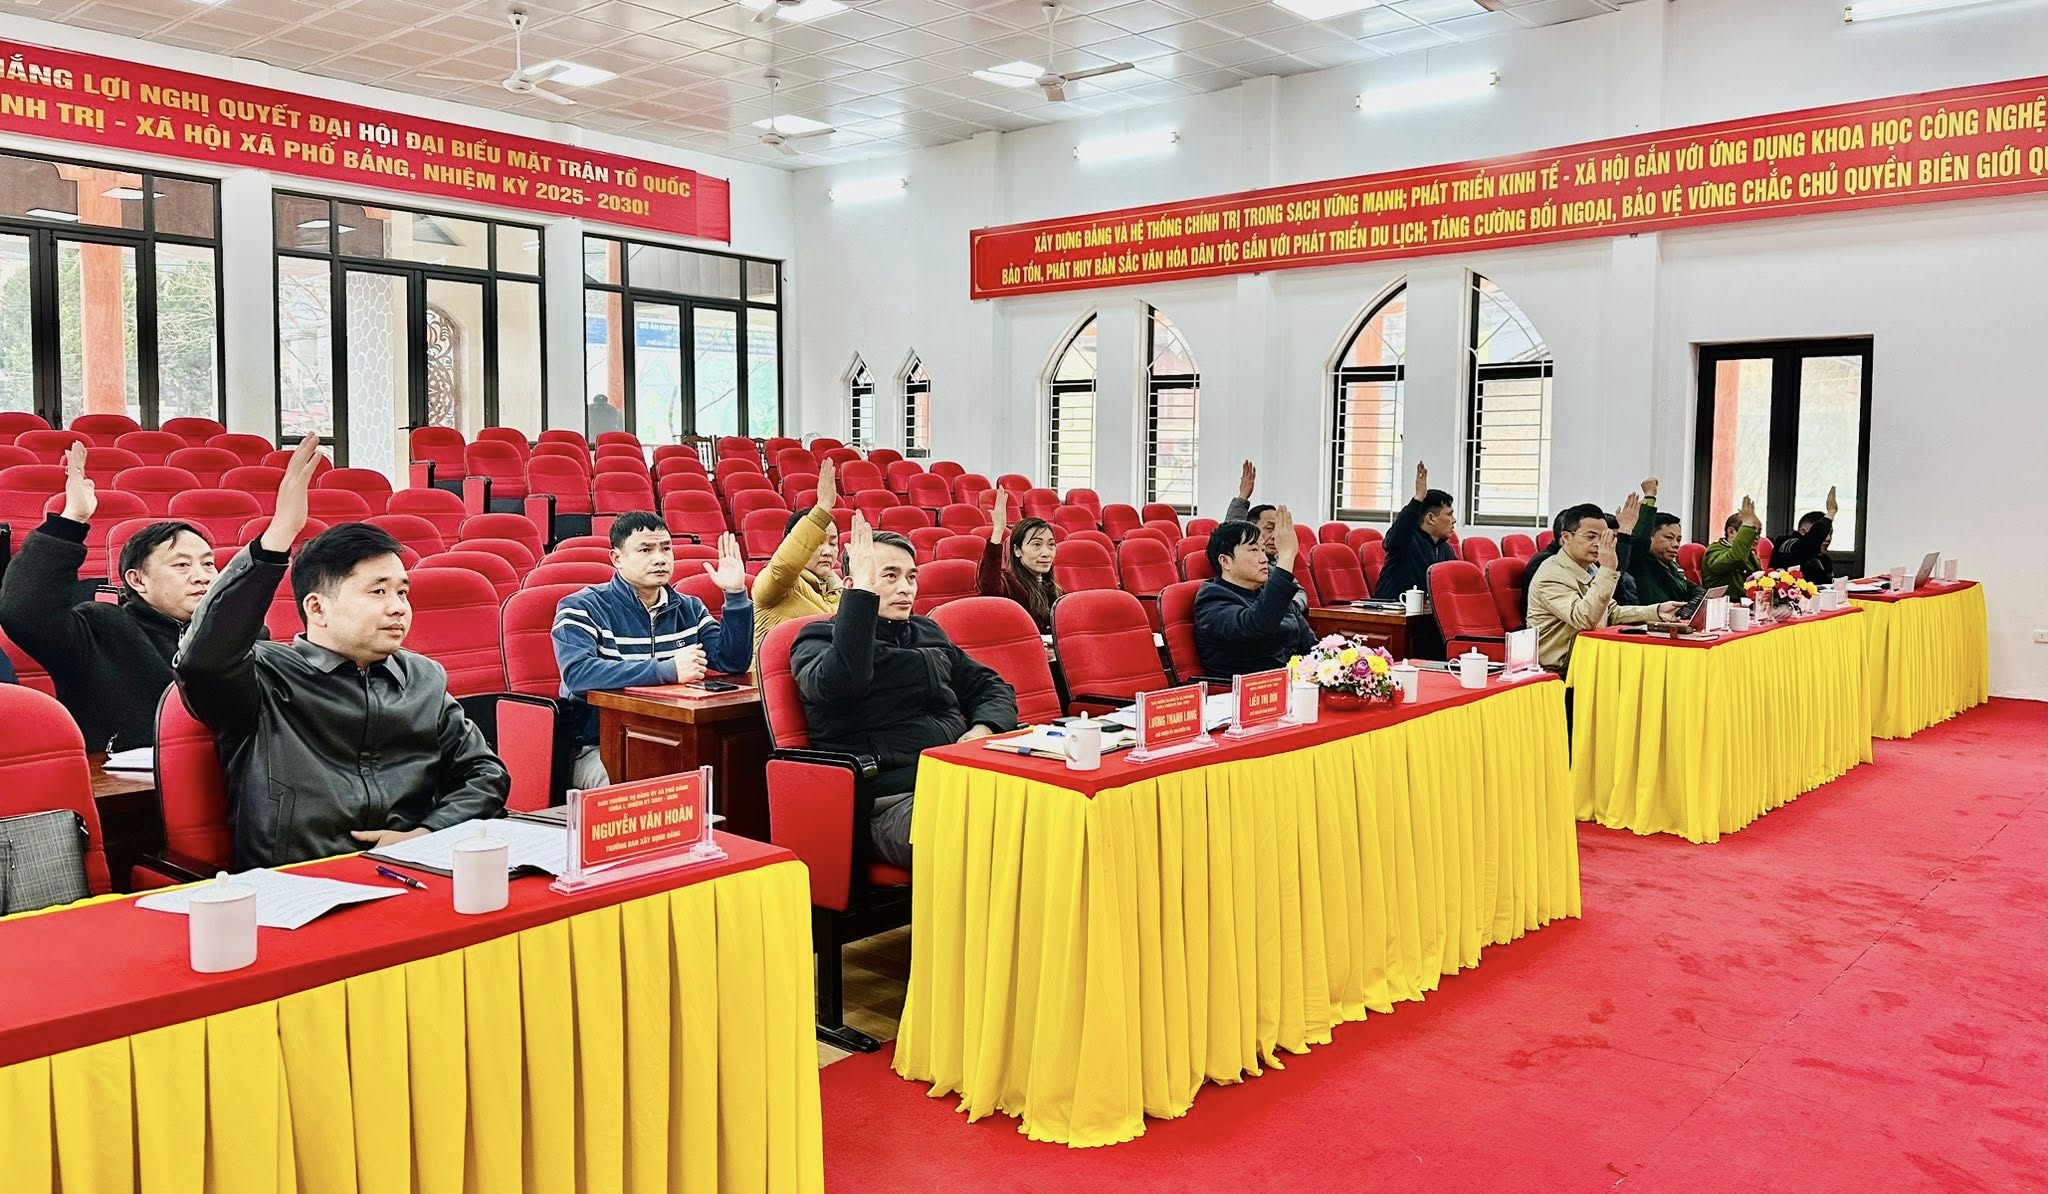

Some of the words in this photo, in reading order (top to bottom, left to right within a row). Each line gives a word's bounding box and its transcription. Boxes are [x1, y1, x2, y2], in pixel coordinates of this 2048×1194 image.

[57, 103, 103, 132] TRỊ
[136, 116, 174, 139] XÃ
[185, 124, 230, 150] HỘI
[240, 133, 275, 155] XÃ
[285, 141, 334, 164] PHỐ
[344, 148, 415, 179] BẢNG,
[424, 164, 495, 190] NHIỆM
[503, 177, 528, 195] KỲ
[536, 183, 591, 204] 2025-
[598, 194, 649, 215] 2030!
[85, 74, 129, 101] LỢI
[141, 84, 208, 117] NGHỊ
[219, 99, 300, 128] QUYẾT
[309, 115, 350, 139] ĐẠI
[359, 123, 398, 147] HỘI
[406, 132, 443, 155] ĐẠI
[452, 137, 502, 163] BIỂU
[508, 151, 551, 173] MẶT
[558, 160, 608, 183] TRẬN
[614, 164, 638, 187] TỔ
[643, 172, 691, 198] QUỐC
[1035, 232, 1052, 252] XÂY
[1056, 231, 1082, 253] DỰNG
[1084, 223, 1112, 247] ĐẢNG
[1115, 222, 1127, 243] VÀ
[1131, 219, 1143, 244] HỆ
[1147, 213, 1181, 239] THỐNG
[1185, 211, 1219, 234] CHÍNH
[1223, 210, 1240, 232] TRỊ
[1244, 204, 1283, 227] TRONG
[1287, 200, 1320, 225] SẠCH
[1324, 193, 1358, 217] VỮNG
[1363, 189, 1407, 216] MẠNH;
[1411, 180, 1448, 207] PHÁT
[1452, 169, 1494, 203] TRIỂN
[1499, 171, 1536, 196] KINH
[1541, 160, 1560, 190] TẾ
[1575, 158, 1596, 186] XÃ
[1602, 153, 1629, 185] HỘI
[1635, 144, 1670, 177] GẮN
[1676, 142, 1703, 172] VỚI
[1710, 139, 1747, 167] ỨNG
[1753, 132, 1805, 165] DỤNG
[1812, 125, 1864, 154] KHOA
[1871, 118, 1912, 150] HỌC
[1920, 108, 1978, 141] CÔNG
[1986, 96, 2046, 133] NGHỆ
[1003, 263, 1020, 284] BẢO
[1023, 262, 1043, 282] TỒN,
[1046, 256, 1070, 280] PHÁT
[1073, 260, 1092, 277] HUY
[1095, 252, 1115, 275] BẢN
[1119, 249, 1139, 273] SẮC
[1142, 249, 1163, 270] VĂN
[1167, 246, 1188, 267] HÓA
[1191, 243, 1214, 265] DÂN
[1218, 239, 1239, 264] TỘC
[1243, 233, 1266, 259] GẮN
[1271, 233, 1290, 256] VỚI
[1294, 229, 1326, 254] PHÁT
[1329, 221, 1367, 250] TRIỂN
[1371, 225, 1389, 246] DU
[1393, 221, 1428, 248] LỊCH;
[1432, 215, 1469, 240] TĂNG
[1474, 207, 1525, 235] CƯỜNG
[1530, 198, 1556, 229] ĐỐI
[1562, 198, 1616, 225] NGOẠI,
[1622, 186, 1656, 218] BẢO
[1661, 184, 1683, 218] VỆ
[1688, 181, 1736, 210] VỮNG
[1743, 168, 1792, 204] CHẮC
[1799, 162, 1838, 197] CHỦ
[1845, 155, 1912, 195] QUYỀN
[1919, 152, 1969, 184] BIÊN
[1977, 145, 2020, 179] GIỚI
[591, 813, 637, 841] NGUYỄN
[640, 810, 662, 831] VĂN
[665, 804, 693, 825] HOÀN
